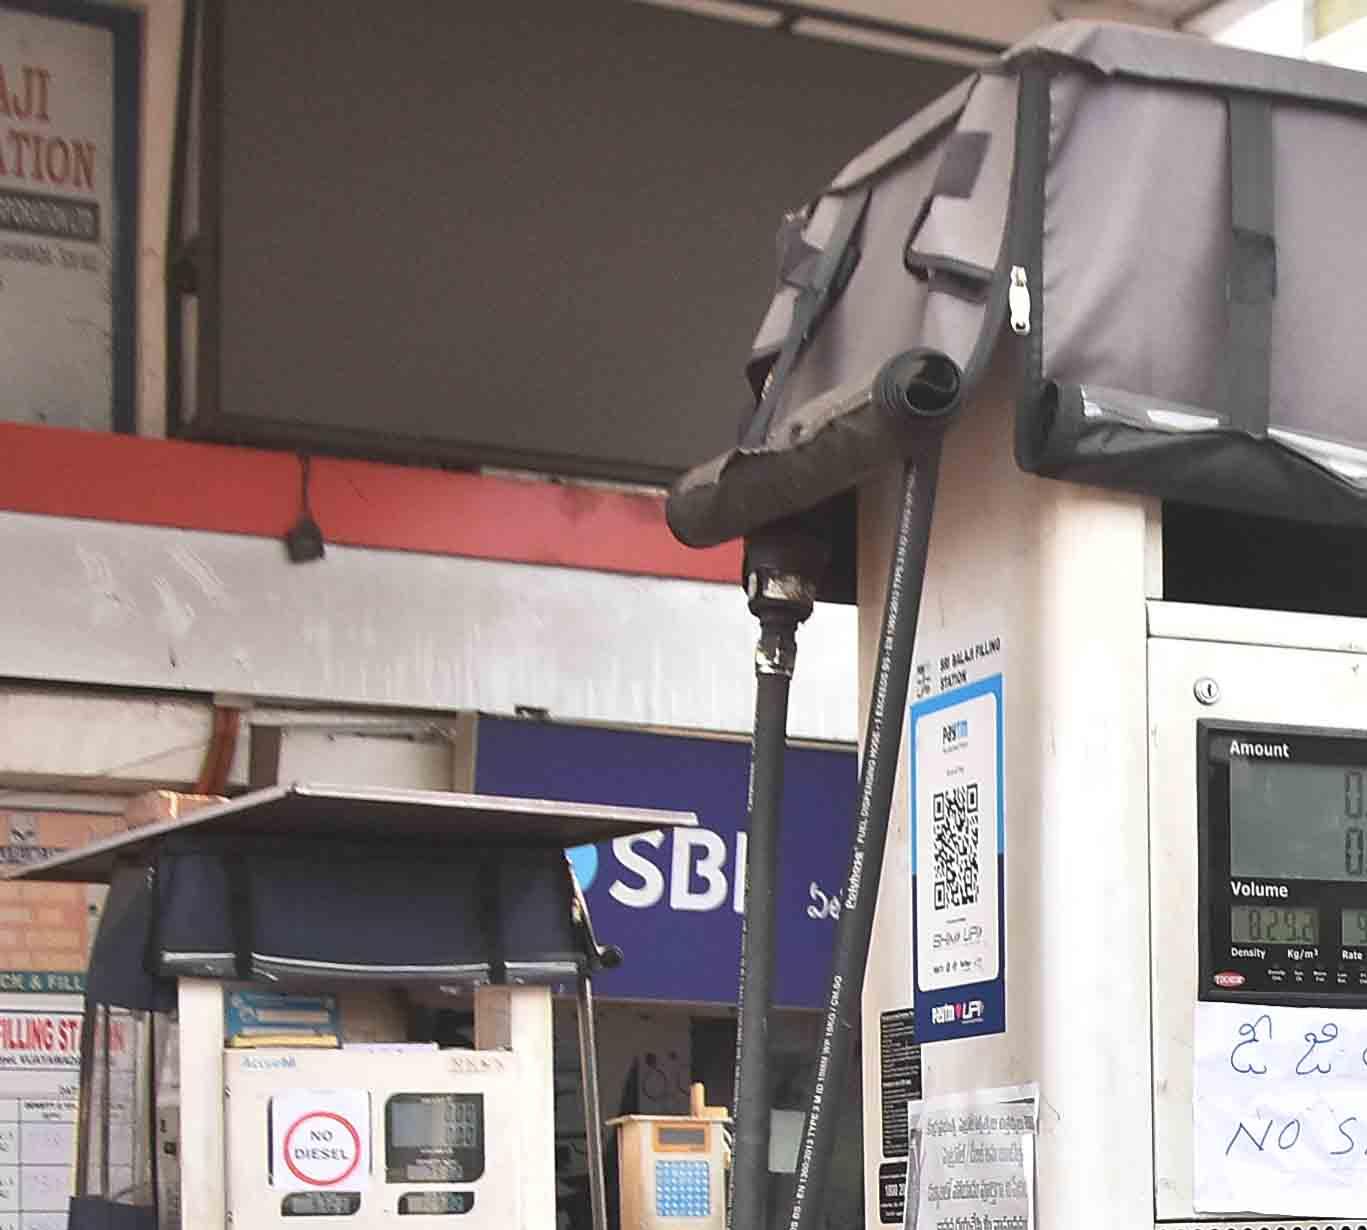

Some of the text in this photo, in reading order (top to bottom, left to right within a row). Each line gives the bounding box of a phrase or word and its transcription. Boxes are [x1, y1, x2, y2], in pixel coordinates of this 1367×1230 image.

[1229, 740, 1289, 758] Amount
[608, 827, 748, 914] SBI
[1231, 882, 1288, 898] Volume
[1232, 948, 1266, 959] Density
[1342, 951, 1362, 960] Rate
[805, 1112, 821, 1138] TYPE
[309, 1129, 333, 1142] NO
[1226, 1119, 1300, 1155] NO
[294, 1147, 348, 1161] DIESEL
